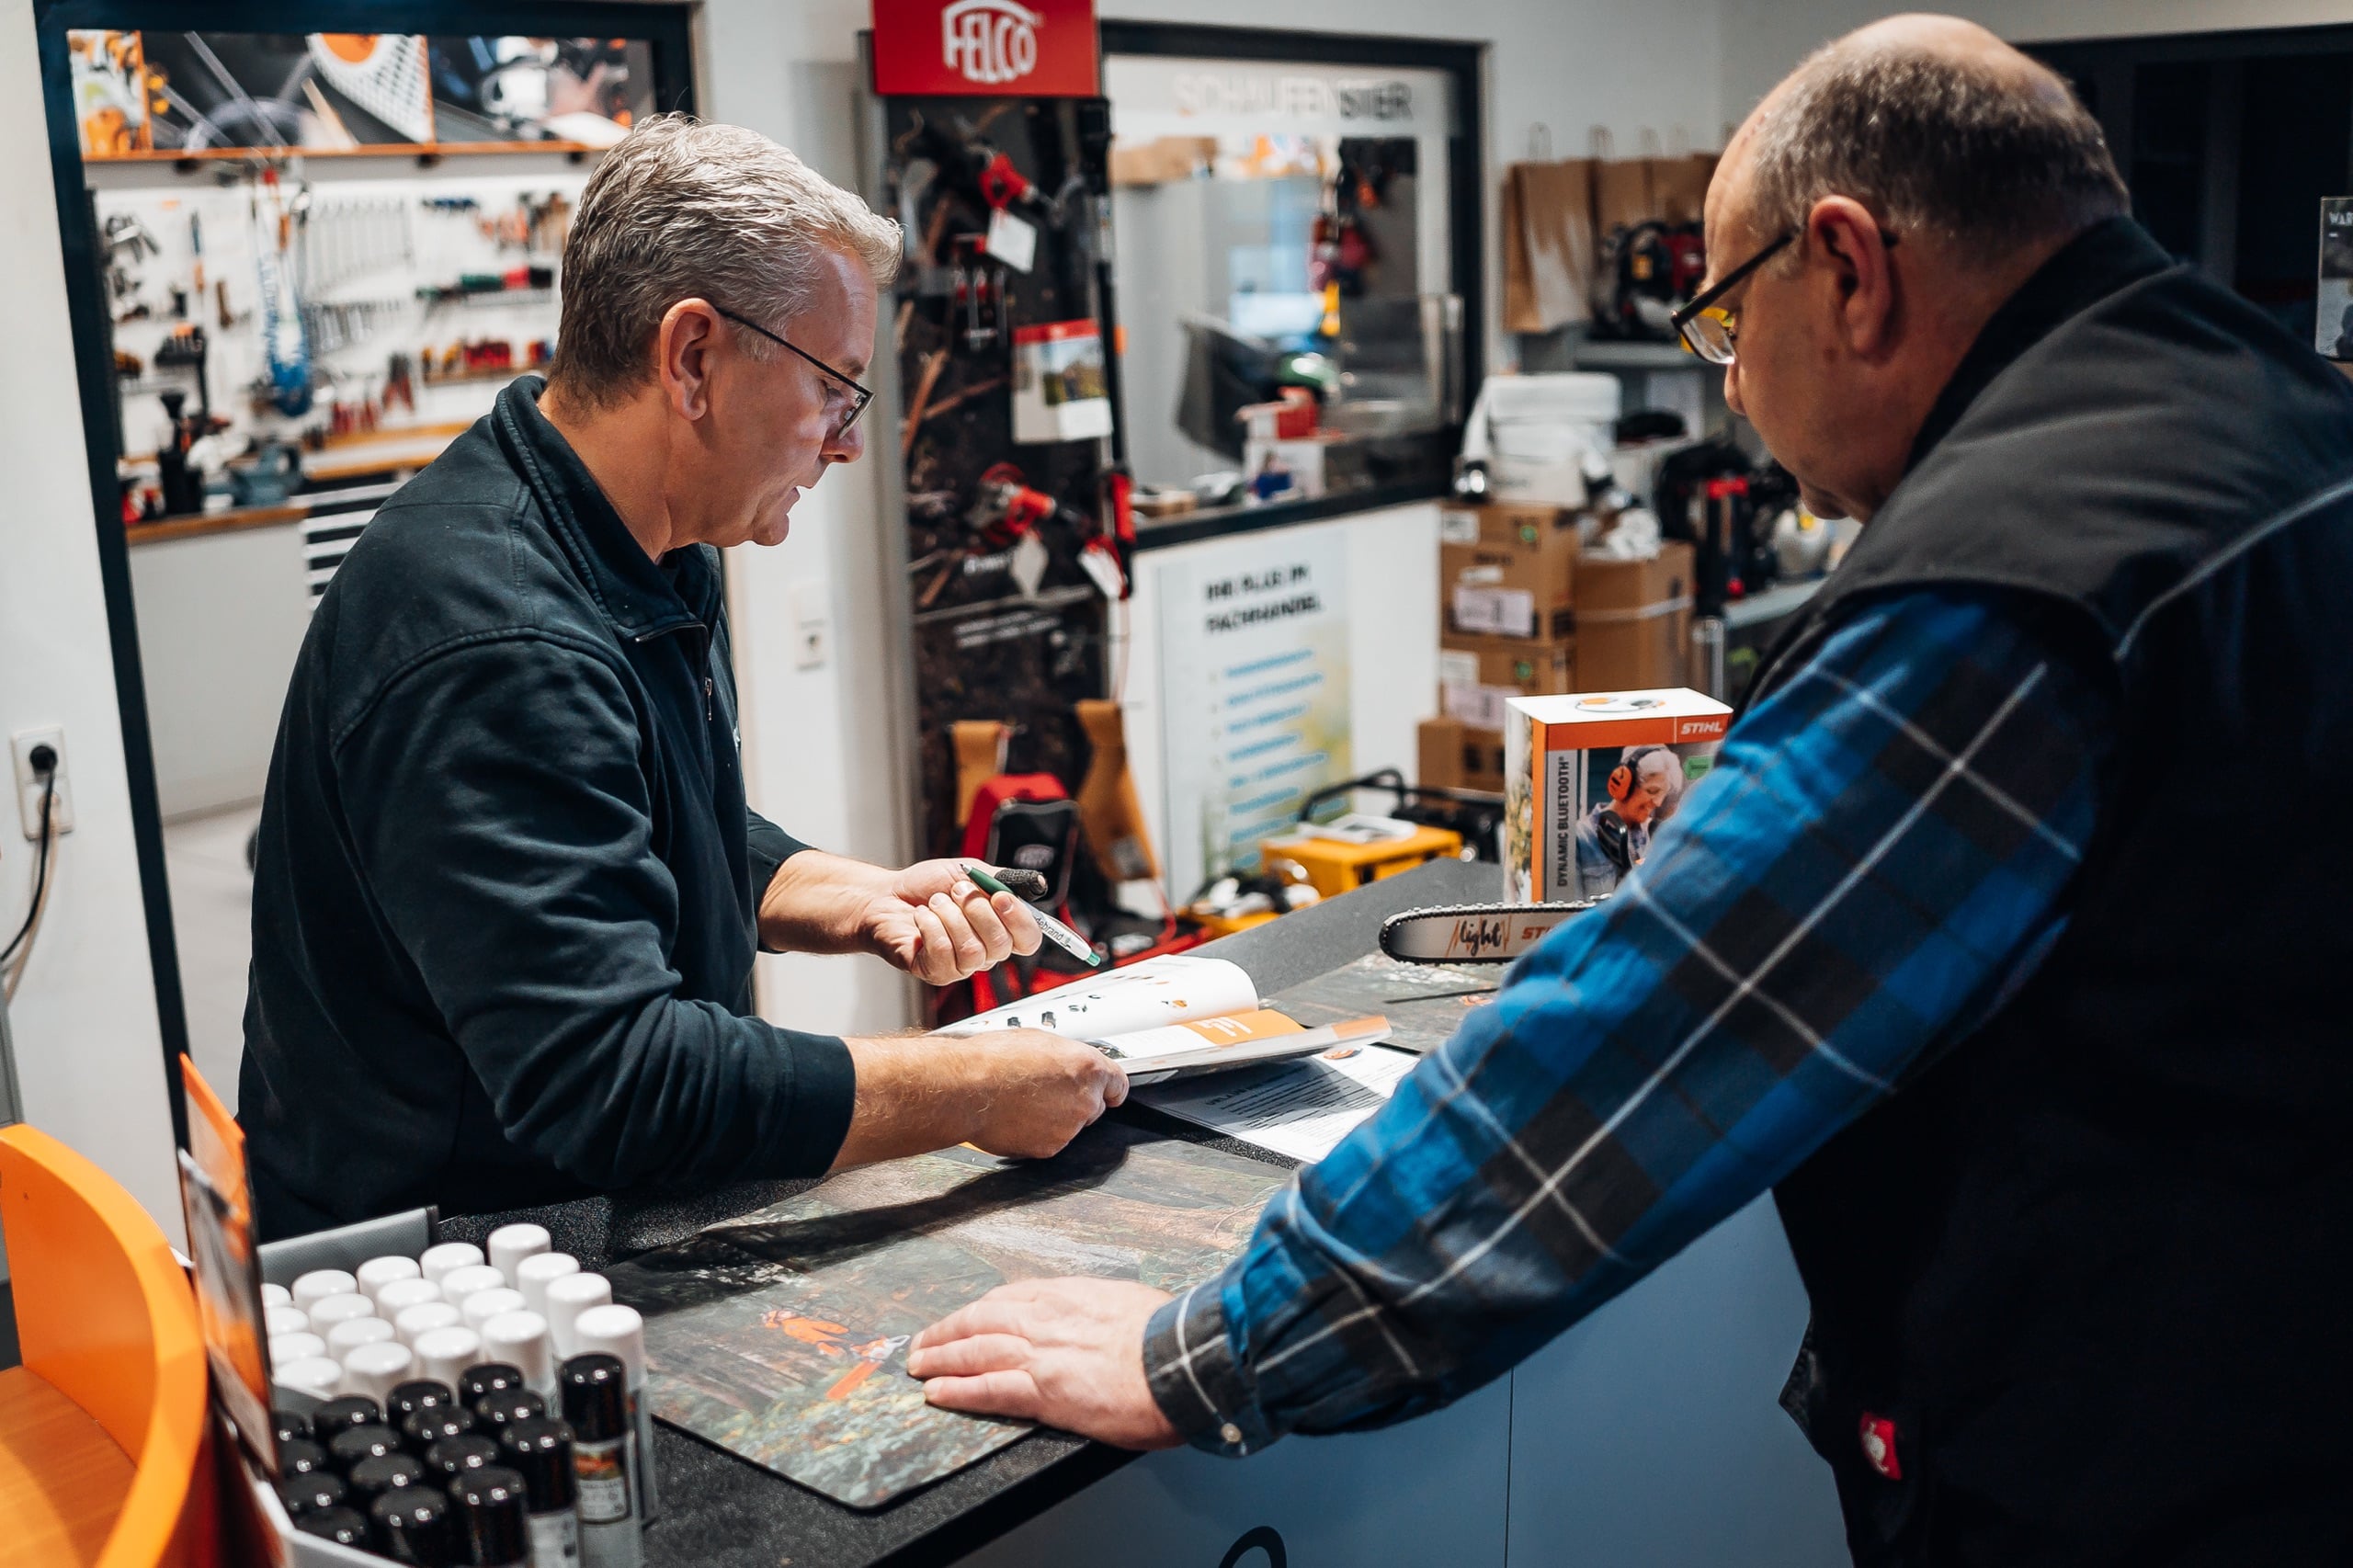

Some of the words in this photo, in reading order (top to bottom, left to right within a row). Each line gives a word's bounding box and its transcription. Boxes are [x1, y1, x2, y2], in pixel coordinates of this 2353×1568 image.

[941, 0, 1037, 84] FELCO
[2328, 211, 2353, 226] WAR
[1680, 722, 1723, 734] STIHL
[1557, 833, 1568, 887] DYNAMIC
[1034, 915, 1063, 941] debrand
[1461, 919, 1504, 957] light
